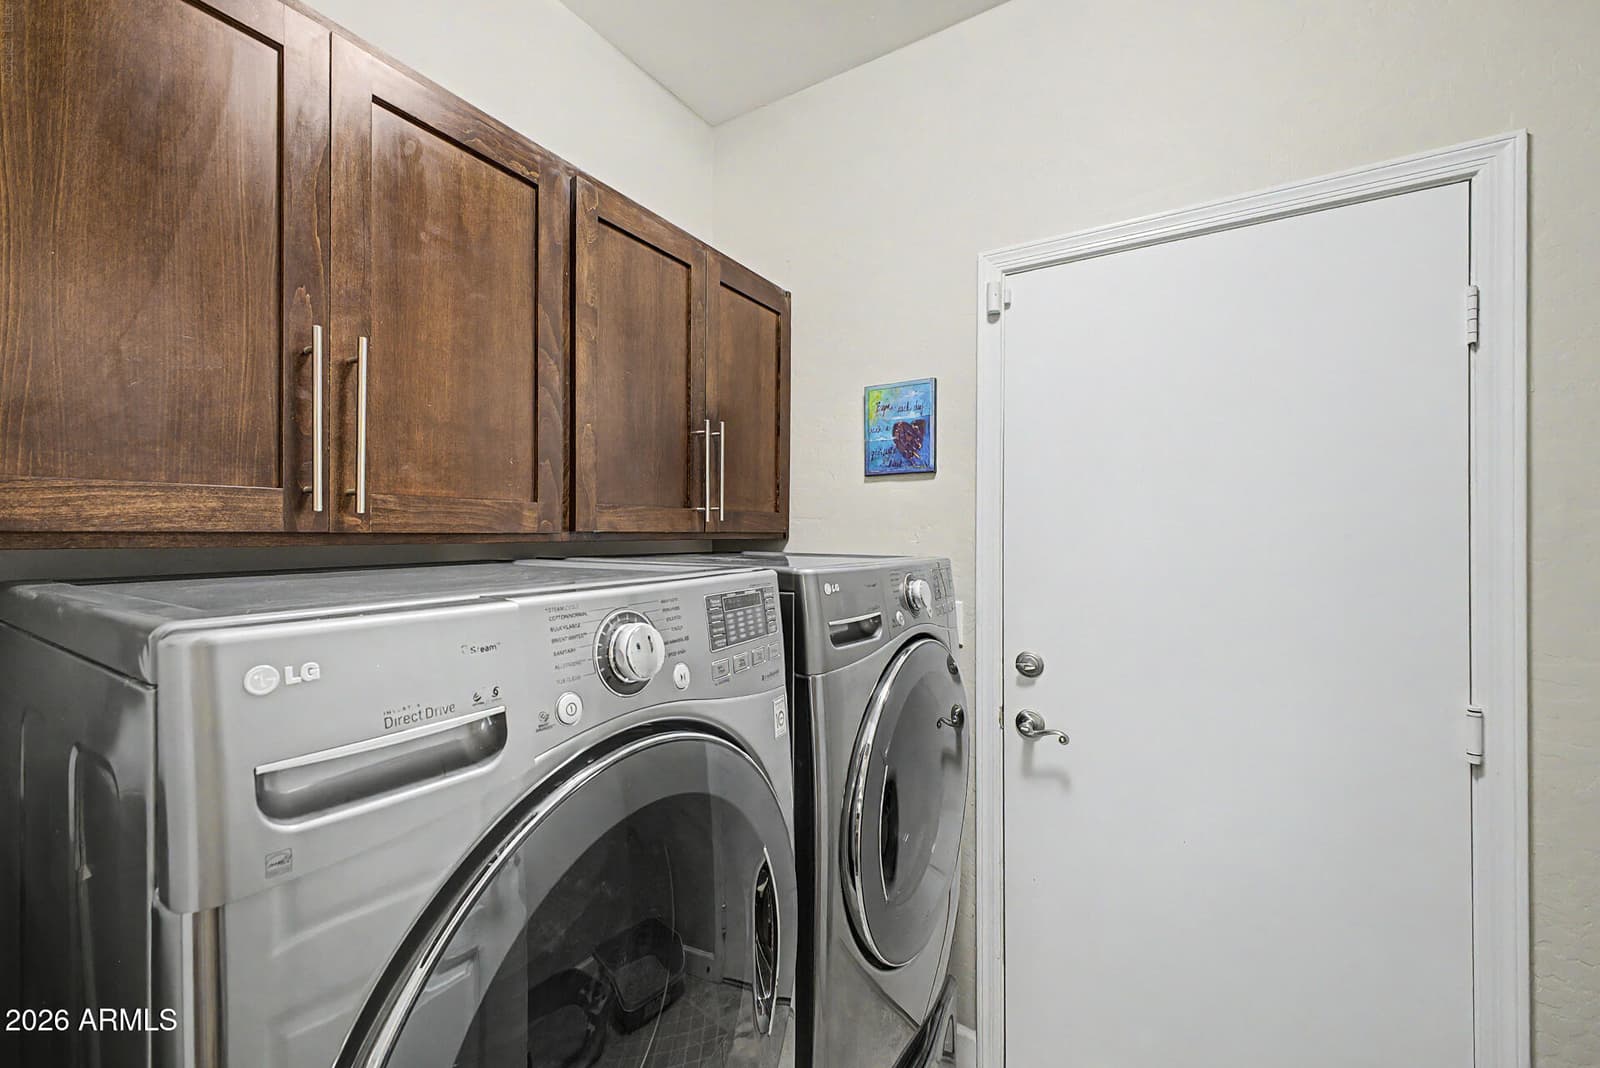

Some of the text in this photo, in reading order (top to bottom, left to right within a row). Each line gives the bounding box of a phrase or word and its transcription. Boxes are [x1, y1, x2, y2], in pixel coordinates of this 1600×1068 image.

[284, 662, 321, 685] LG
[384, 710, 423, 729] Direct
[425, 703, 456, 719] Drive
